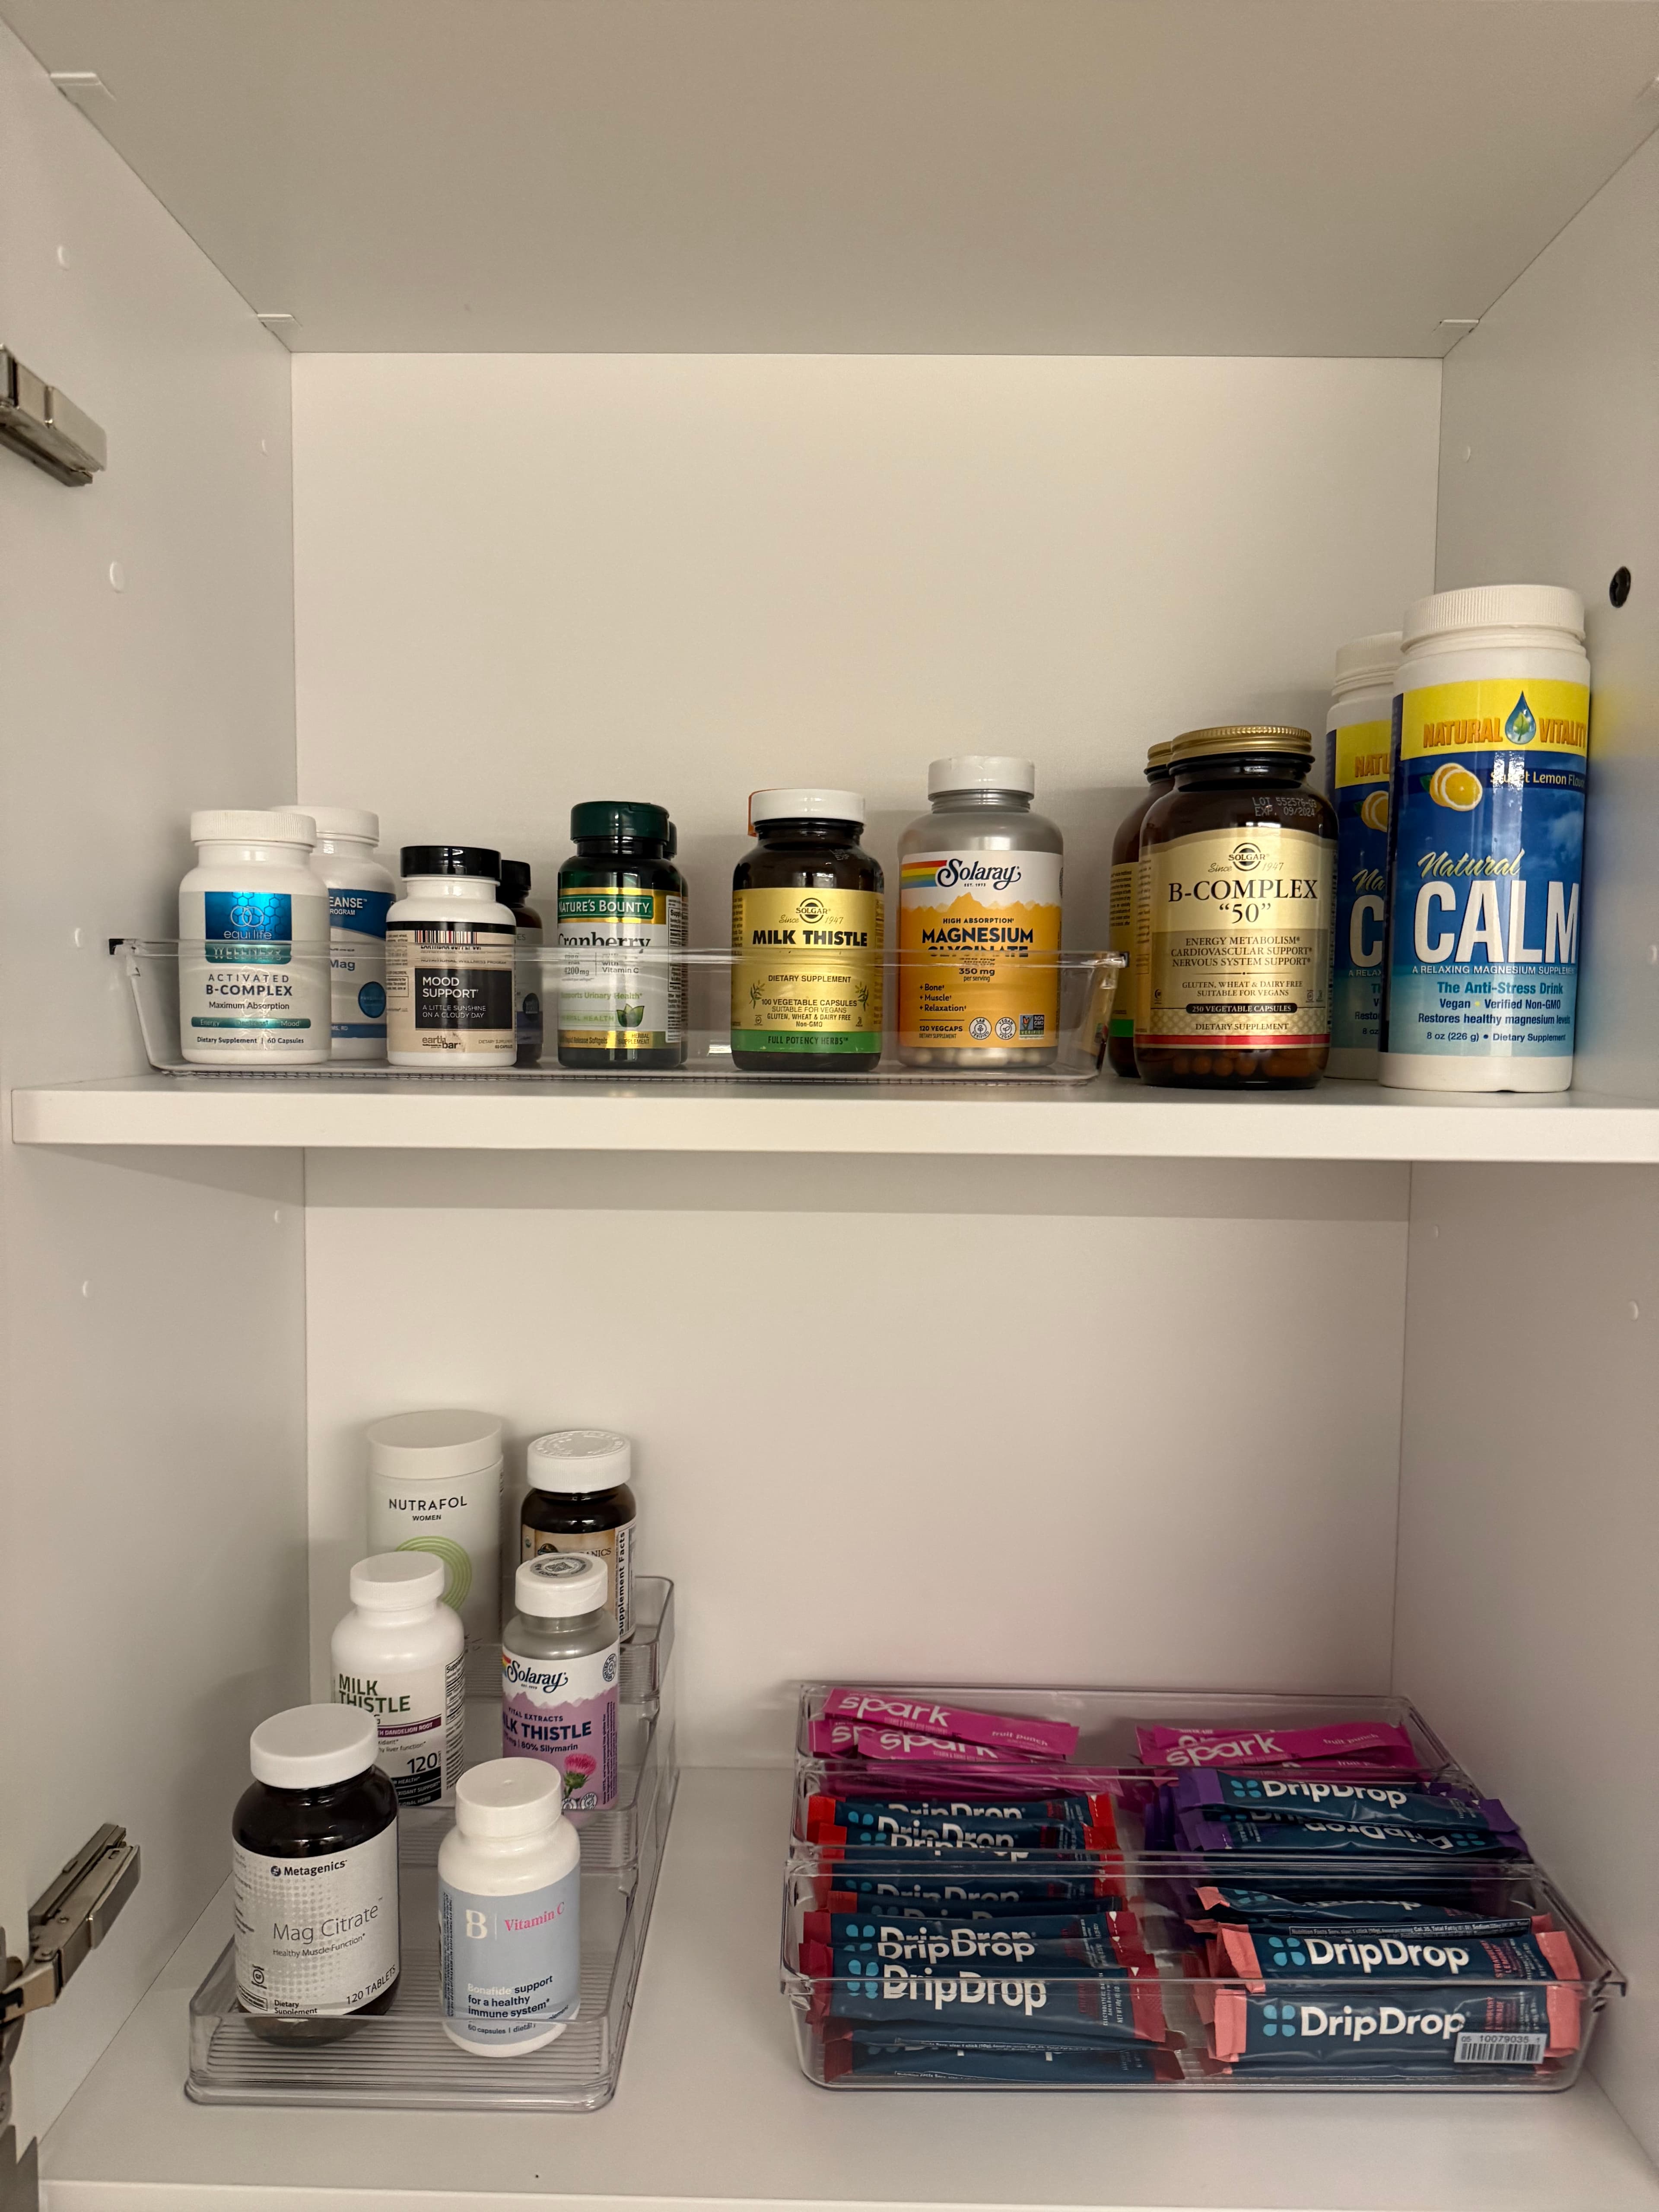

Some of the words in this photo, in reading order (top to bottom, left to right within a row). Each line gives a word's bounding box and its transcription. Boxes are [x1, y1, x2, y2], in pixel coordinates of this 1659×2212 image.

[1423, 718, 1503, 748] NATURAL
[1533, 772, 1566, 785] Lemon
[1252, 797, 1270, 806] LOT
[1255, 807, 1277, 816] EXP.
[1283, 807, 1314, 817] 09/2024
[1208, 862, 1233, 873] Since
[1262, 862, 1284, 871] 1947
[1417, 847, 1525, 878] Natural
[937, 858, 1021, 890] Solaray
[1168, 879, 1318, 903] B-COMPLEX
[599, 900, 649, 913] BOUNTY
[779, 914, 799, 924] Since
[825, 916, 843, 925] 1947
[1414, 880, 1580, 964] CALM
[253, 929, 272, 940] life
[753, 930, 796, 945] MILK
[802, 930, 868, 947] THISTLE
[922, 928, 1033, 944] MAGNESIUM
[1186, 937, 1227, 946] ENERGY
[1171, 947, 1264, 957] CARDIOVASCULAR
[1173, 958, 1218, 967] NERVOUS
[1220, 958, 1261, 966] SYSTEM
[1420, 965, 1470, 974] RELAXING
[1473, 965, 1536, 975] MAGNESIUM
[208, 974, 289, 983] ACTIVATED
[423, 976, 460, 986] MOOD
[206, 984, 293, 996] B-COMPLEX
[1437, 982, 1460, 993] The
[1465, 982, 1536, 994] Anti-Stress
[1540, 983, 1563, 994] Drink
[585, 992, 610, 1000] Urinary
[209, 1001, 245, 1009] Maximum
[247, 1002, 289, 1011] Absorption
[1439, 998, 1471, 1010] Vegan
[1484, 999, 1522, 1009] Verified
[1525, 999, 1561, 1009] Non-GMO
[1418, 1013, 1460, 1023] Restores
[1464, 1014, 1502, 1026] healthy
[1505, 1014, 1554, 1026] magnesium
[422, 1036, 446, 1044] earth
[785, 1036, 818, 1045] POTENCY
[1448, 1032, 1467, 1042] (226
[1470, 1032, 1479, 1042] g)
[1493, 1033, 1525, 1042] Dietary
[1527, 1033, 1566, 1043] Supplement
[442, 1040, 457, 1049] bar
[389, 1495, 467, 1511] NUTRAFOL
[507, 1660, 569, 1694] Solaray
[339, 1673, 378, 1696] MILK
[339, 1690, 411, 1713] THISTLE
[524, 1713, 563, 1723] EXTRACTS
[838, 1696, 951, 1727] spark
[385, 1726, 418, 1736] DANDELION
[419, 1722, 433, 1730] ROOT
[521, 1721, 592, 1741] THISTLE
[1016, 1734, 1048, 1746] punch
[521, 1741, 538, 1751] 80%
[540, 1743, 578, 1754] Silymarin
[1166, 1733, 1284, 1767] spark
[407, 1753, 437, 1773] 120
[1262, 1779, 1407, 1809] DripDrop
[284, 1861, 346, 1876] Metagenics
[273, 1923, 314, 1945] Mag
[321, 1904, 378, 1937] Citrate
[465, 1909, 488, 1939] B
[504, 1909, 554, 1932] Vitamin
[556, 1901, 565, 1915] C
[273, 1948, 301, 1958] Healthy
[302, 1946, 329, 1957] Muscle
[877, 1939, 1036, 1964] DripDrop
[1304, 1938, 1469, 1974] DripDrop
[346, 1990, 364, 2005] 120
[365, 1964, 396, 1996] TABLETS
[468, 1983, 512, 1995] Bonafide
[514, 1975, 553, 1994] support
[883, 1964, 1047, 2016] DripDrop
[274, 1999, 299, 2009] Dietary
[468, 1995, 481, 2006] for
[492, 1995, 531, 2007] healthy
[468, 2006, 508, 2018] immune
[1300, 2005, 1466, 2042] DripDrop
